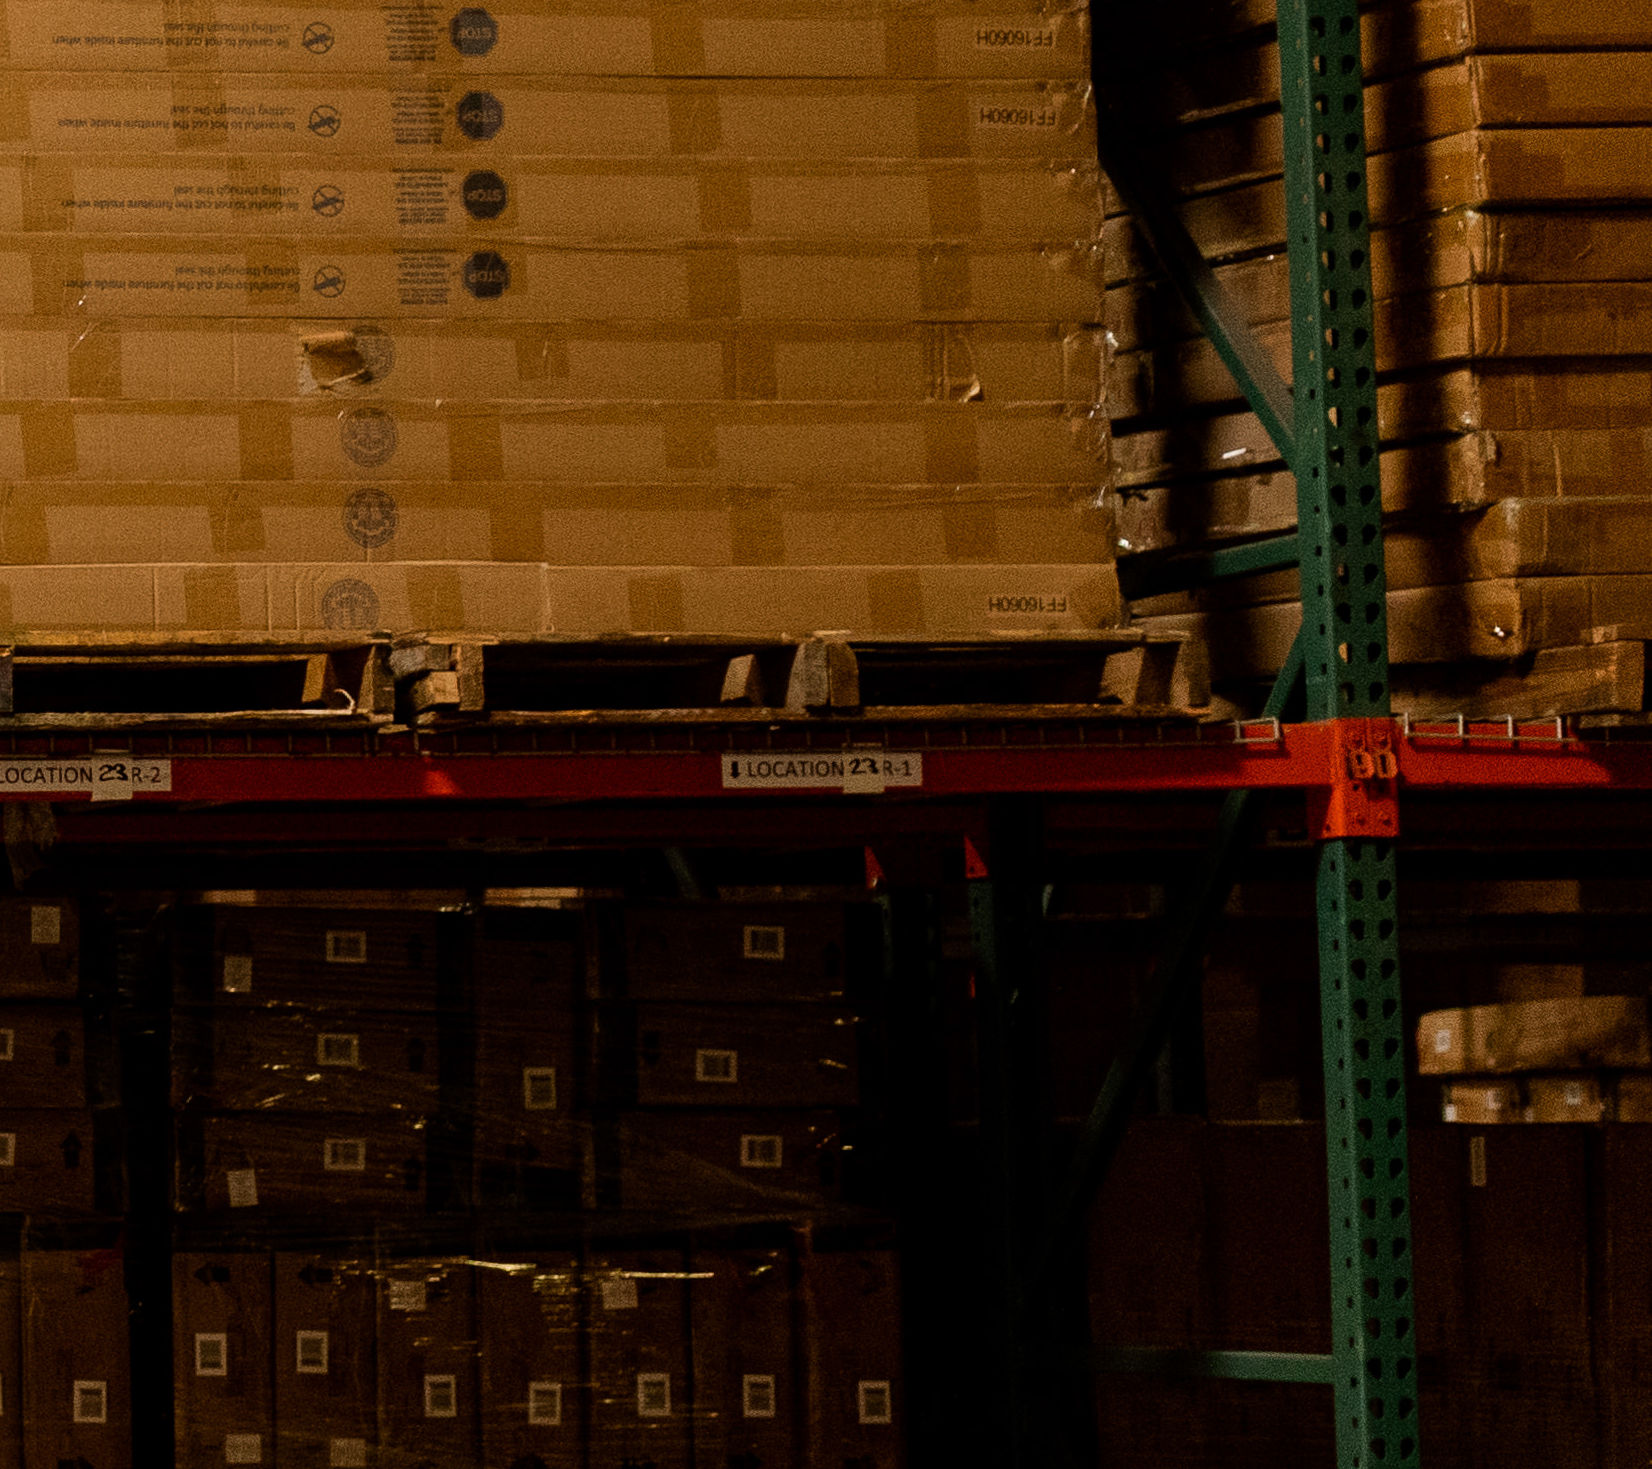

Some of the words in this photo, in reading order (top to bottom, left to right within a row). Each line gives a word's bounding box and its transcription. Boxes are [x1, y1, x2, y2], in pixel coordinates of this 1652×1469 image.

[98, 763, 129, 781] 23
[131, 766, 162, 783] R-2
[747, 761, 845, 779] LOCATION
[849, 758, 879, 774] 23
[883, 760, 913, 777] R-1
